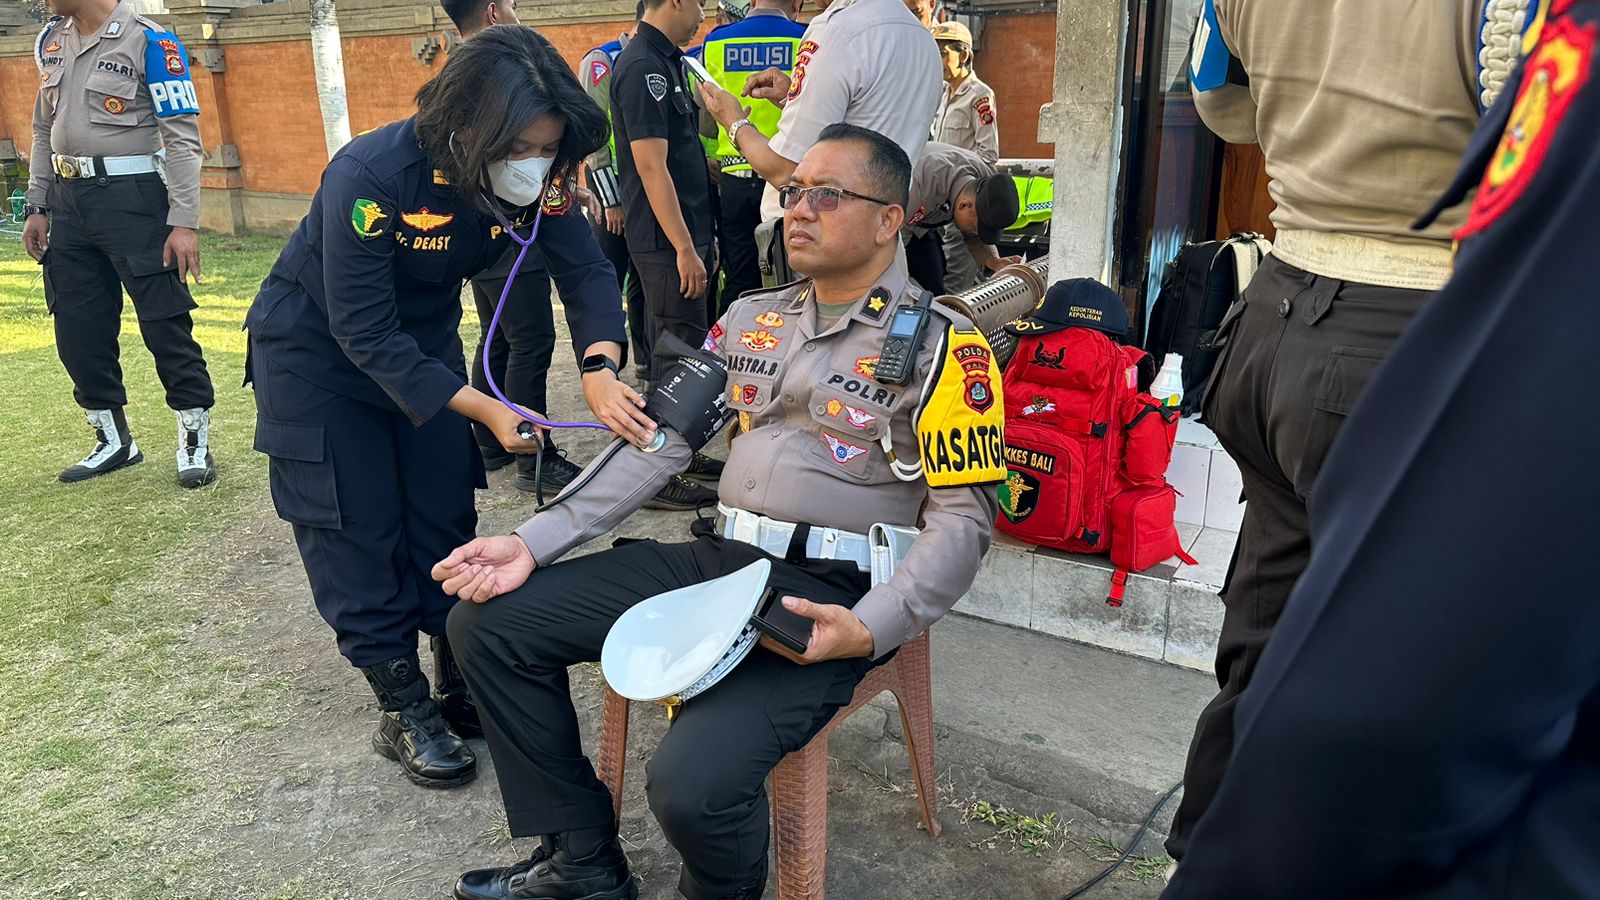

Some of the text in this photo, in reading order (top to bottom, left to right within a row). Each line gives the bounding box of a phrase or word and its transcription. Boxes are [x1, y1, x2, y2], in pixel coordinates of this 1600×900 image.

[726, 46, 789, 66] POLISI
[97, 61, 134, 77] POLRI
[412, 235, 451, 251] DEASY
[1068, 312, 1102, 322] KEPOLISIAN
[956, 347, 988, 359] POLDA
[827, 374, 897, 408] POLRI
[1030, 453, 1053, 472] BALI
